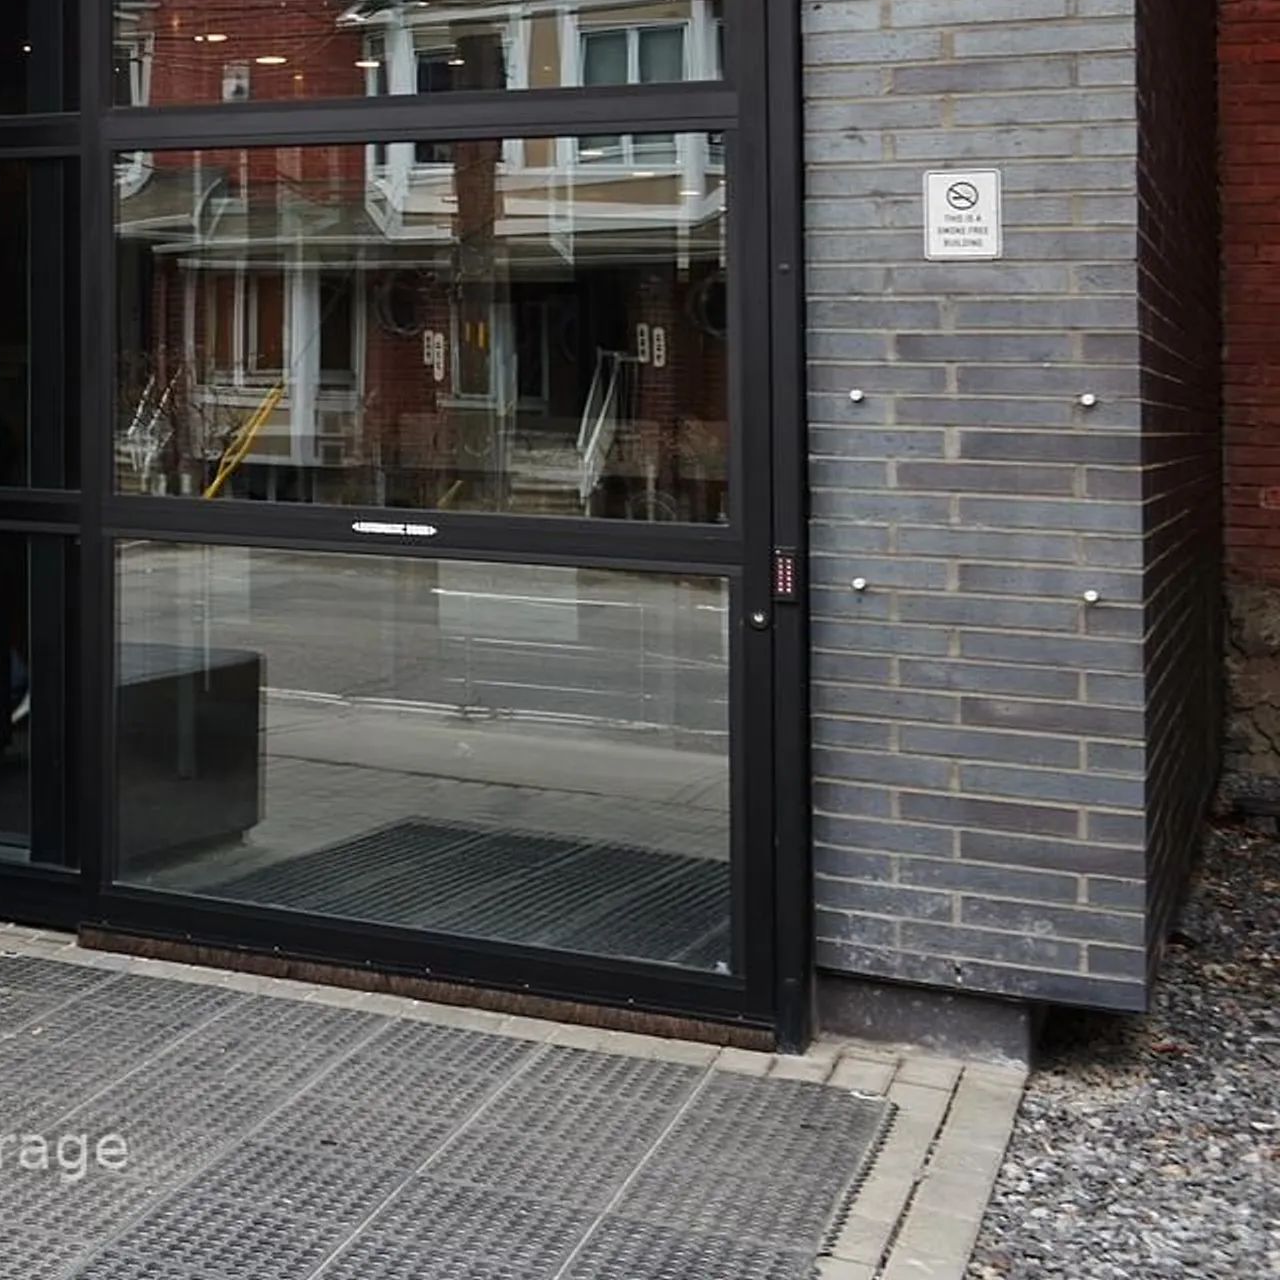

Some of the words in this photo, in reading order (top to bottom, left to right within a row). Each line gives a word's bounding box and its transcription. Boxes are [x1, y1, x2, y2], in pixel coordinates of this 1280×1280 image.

[937, 226, 966, 234] SMOKE
[968, 226, 988, 234] FREE
[943, 238, 983, 247] BUILDING
